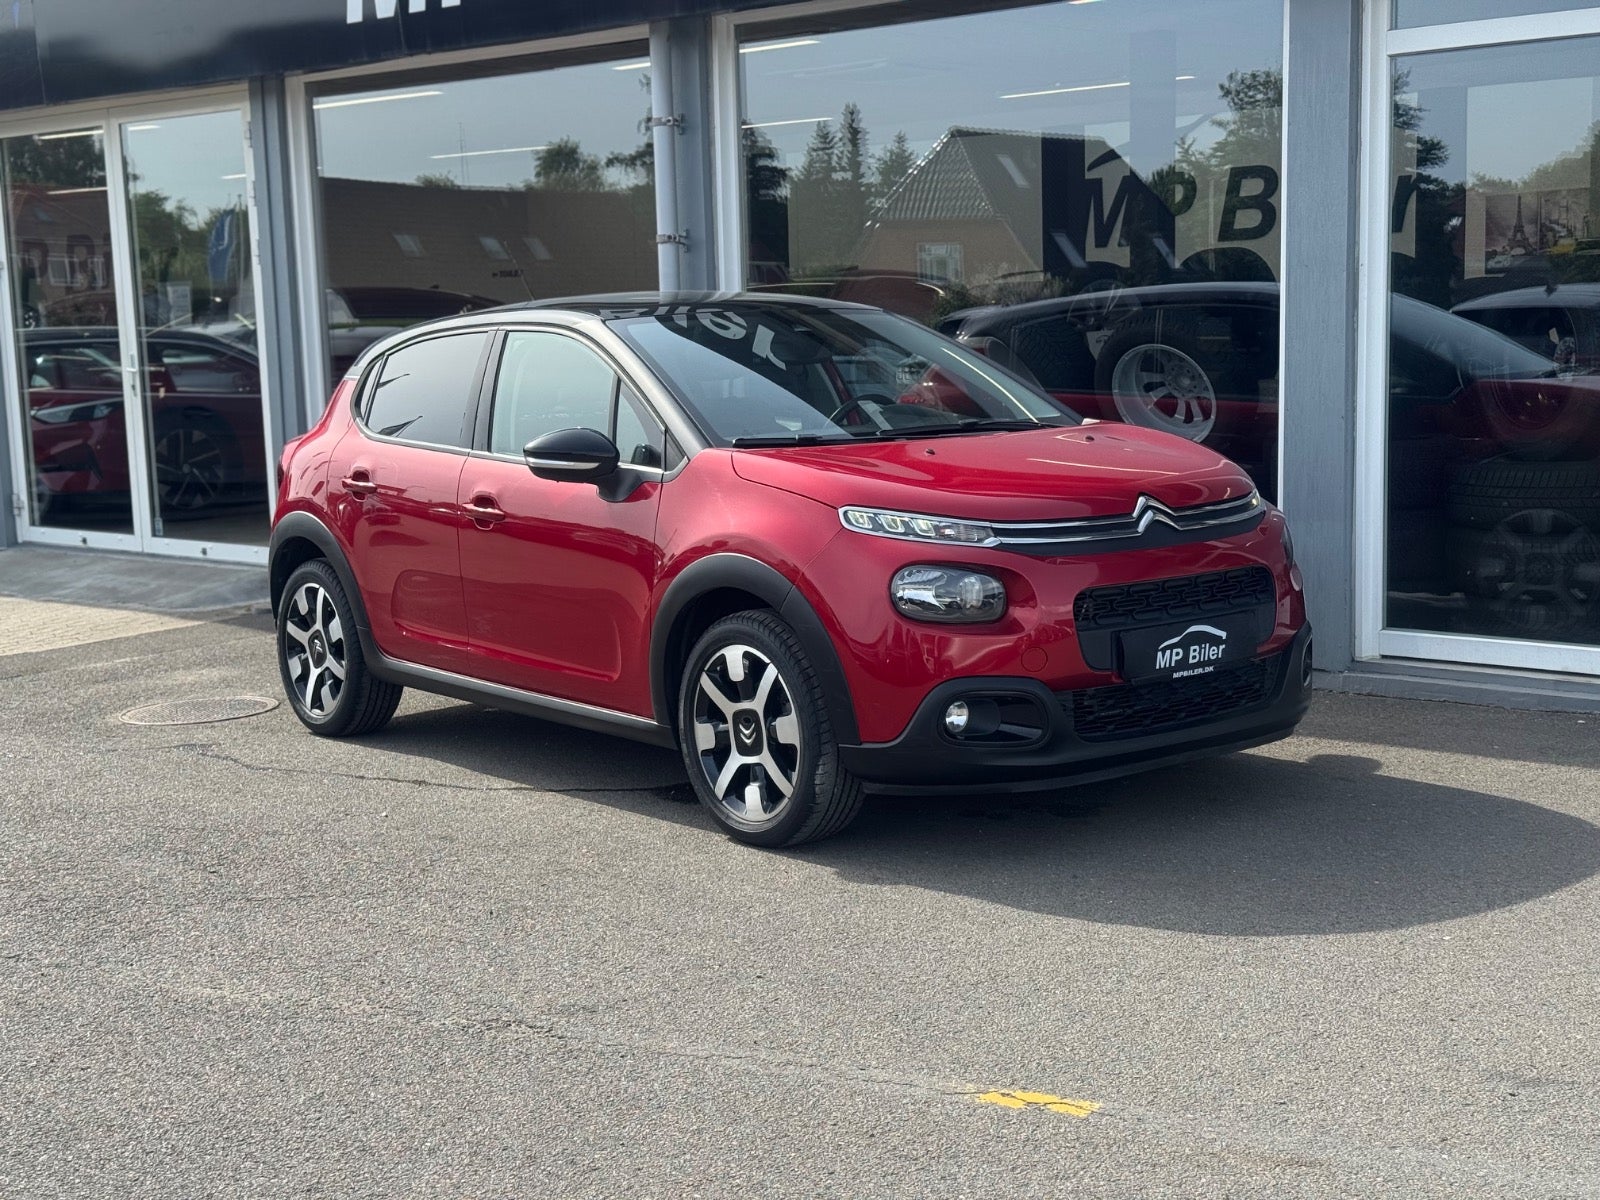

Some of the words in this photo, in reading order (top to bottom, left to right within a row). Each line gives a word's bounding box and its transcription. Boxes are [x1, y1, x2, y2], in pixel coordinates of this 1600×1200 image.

[1156, 648, 1183, 669] MP
[1189, 643, 1225, 664] Biler
[1173, 666, 1214, 678] MPBILER.DK
